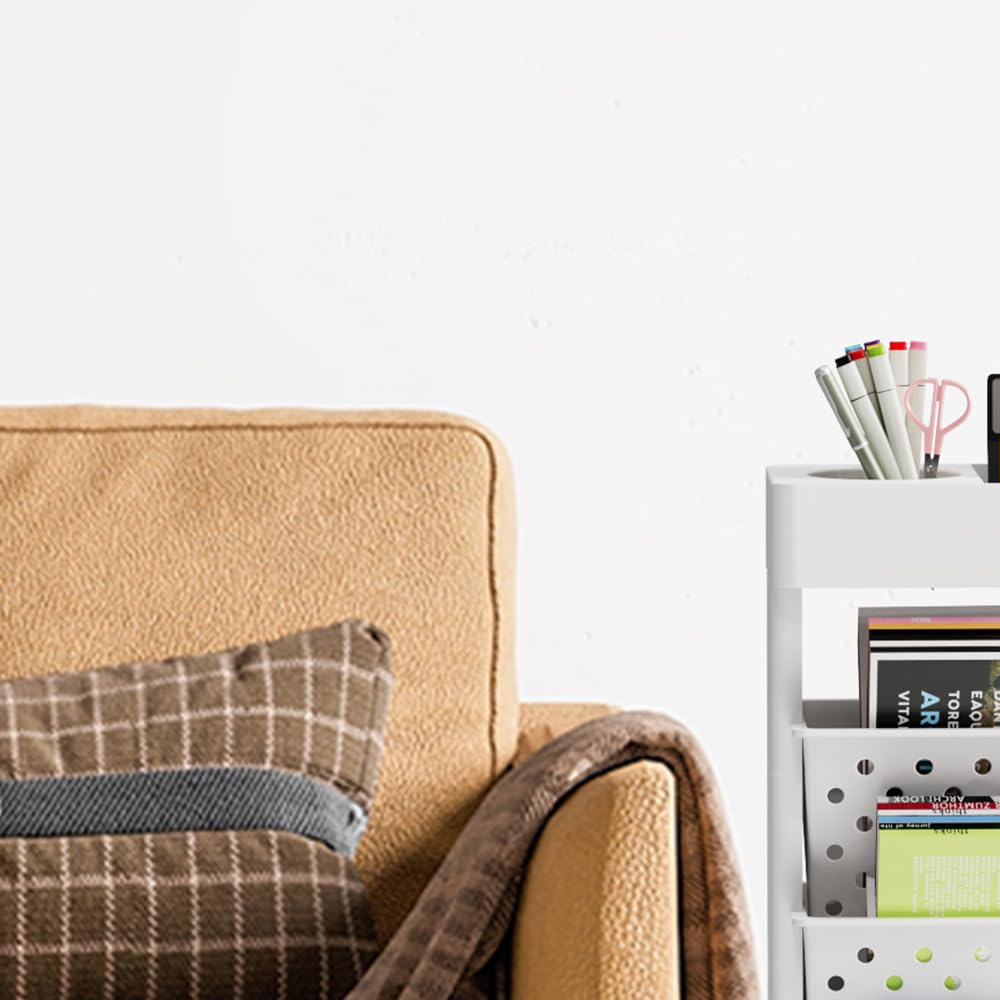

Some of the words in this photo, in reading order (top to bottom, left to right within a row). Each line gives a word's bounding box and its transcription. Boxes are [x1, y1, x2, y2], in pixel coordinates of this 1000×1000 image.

[897, 690, 911, 728] VITA
[929, 795, 964, 803] ARCHI
[931, 801, 990, 809] ZUMTHOR
[931, 808, 967, 816] thinks
